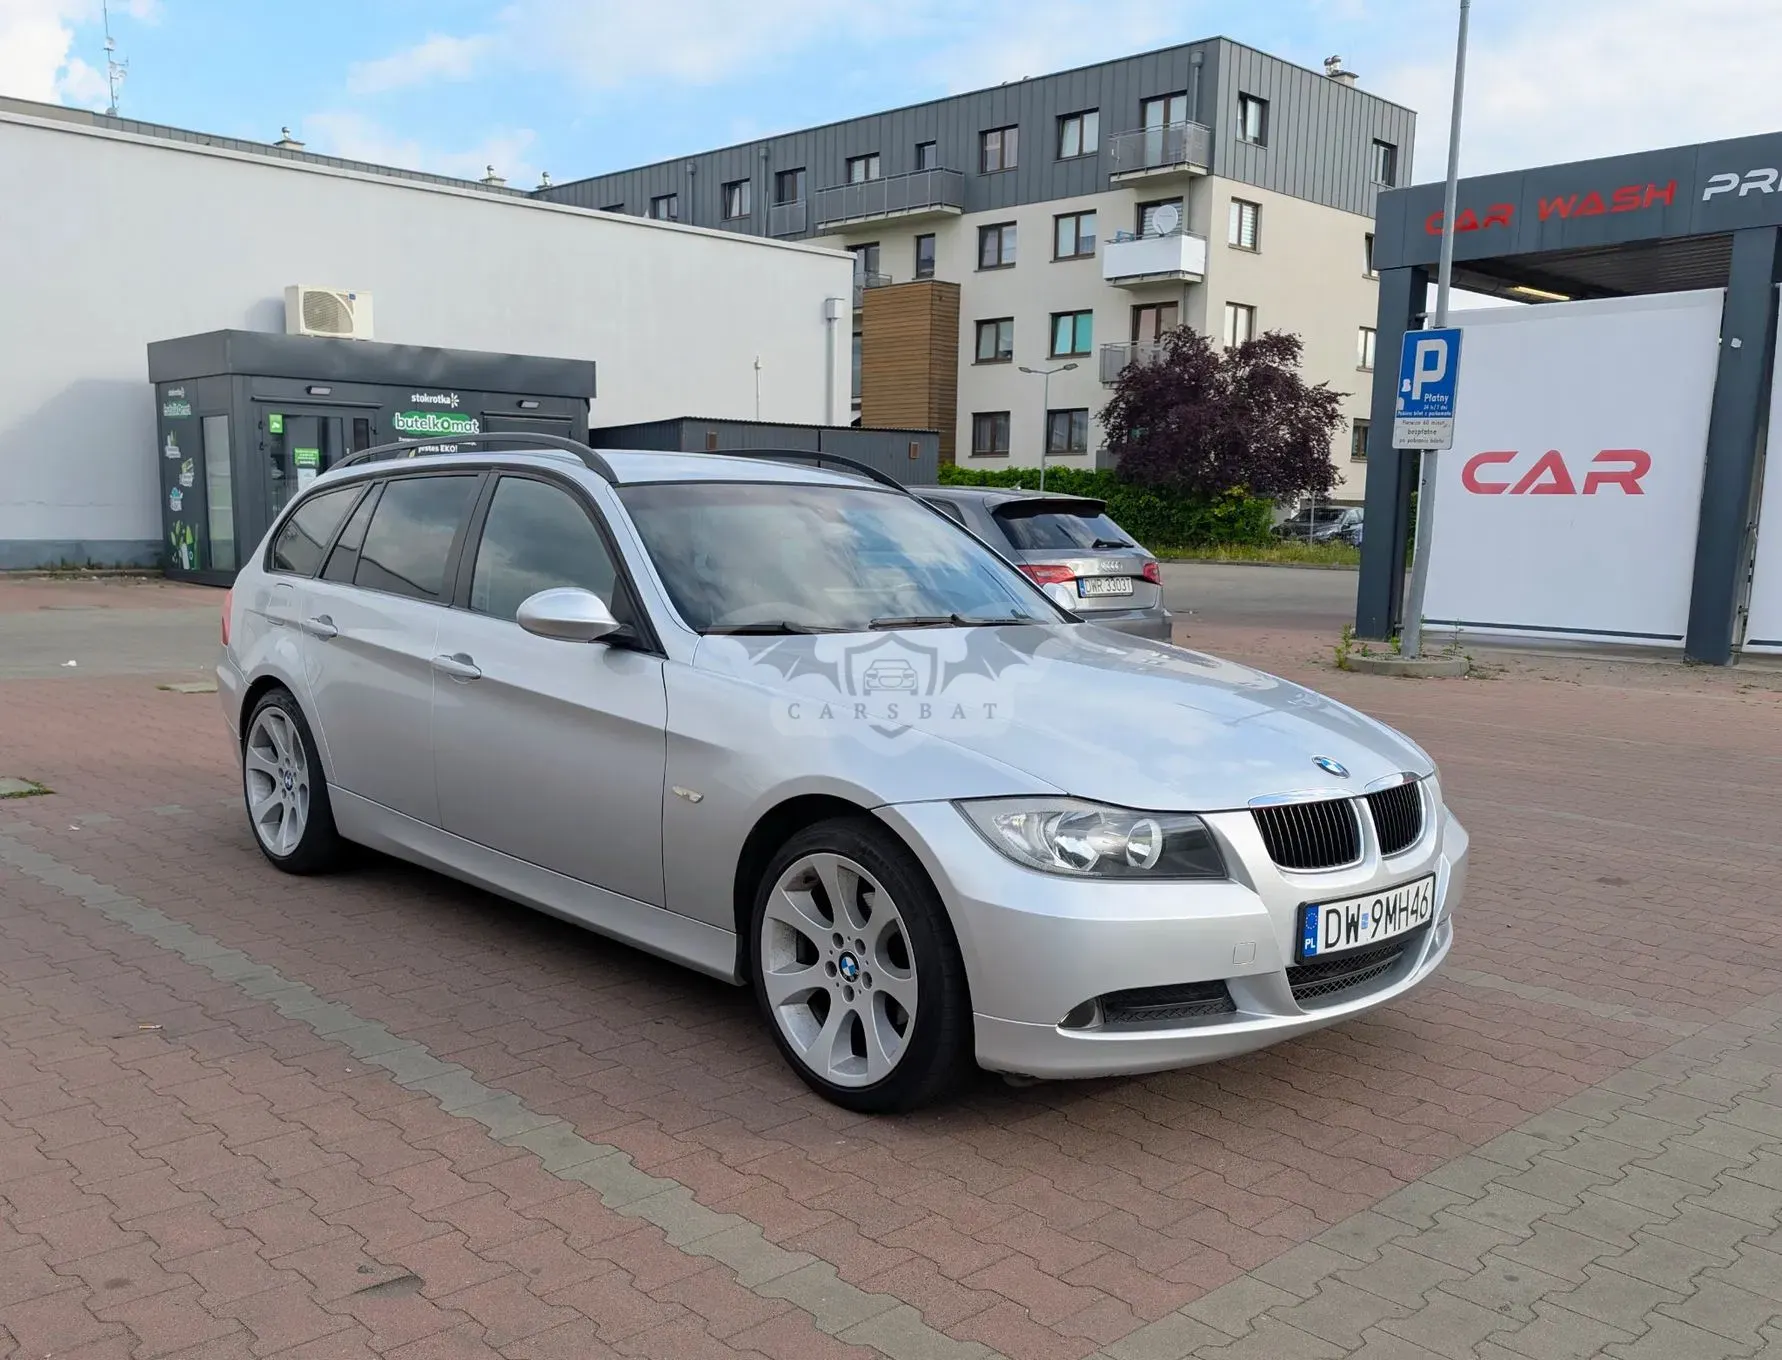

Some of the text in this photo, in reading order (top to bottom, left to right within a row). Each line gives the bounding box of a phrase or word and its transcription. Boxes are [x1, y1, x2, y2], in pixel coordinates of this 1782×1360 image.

[1425, 203, 1515, 236] CAR
[1537, 180, 1677, 222] WASH
[1412, 339, 1448, 400] P
[411, 393, 451, 405] stokrotka
[1424, 393, 1449, 404] Płatny
[395, 412, 479, 434] butelkOmat
[440, 444, 458, 453] EKO!
[1461, 449, 1652, 495] CAR
[1085, 579, 1104, 592] DWR
[1325, 881, 1430, 949] DW 9MH46
[1304, 938, 1316, 950] PL
